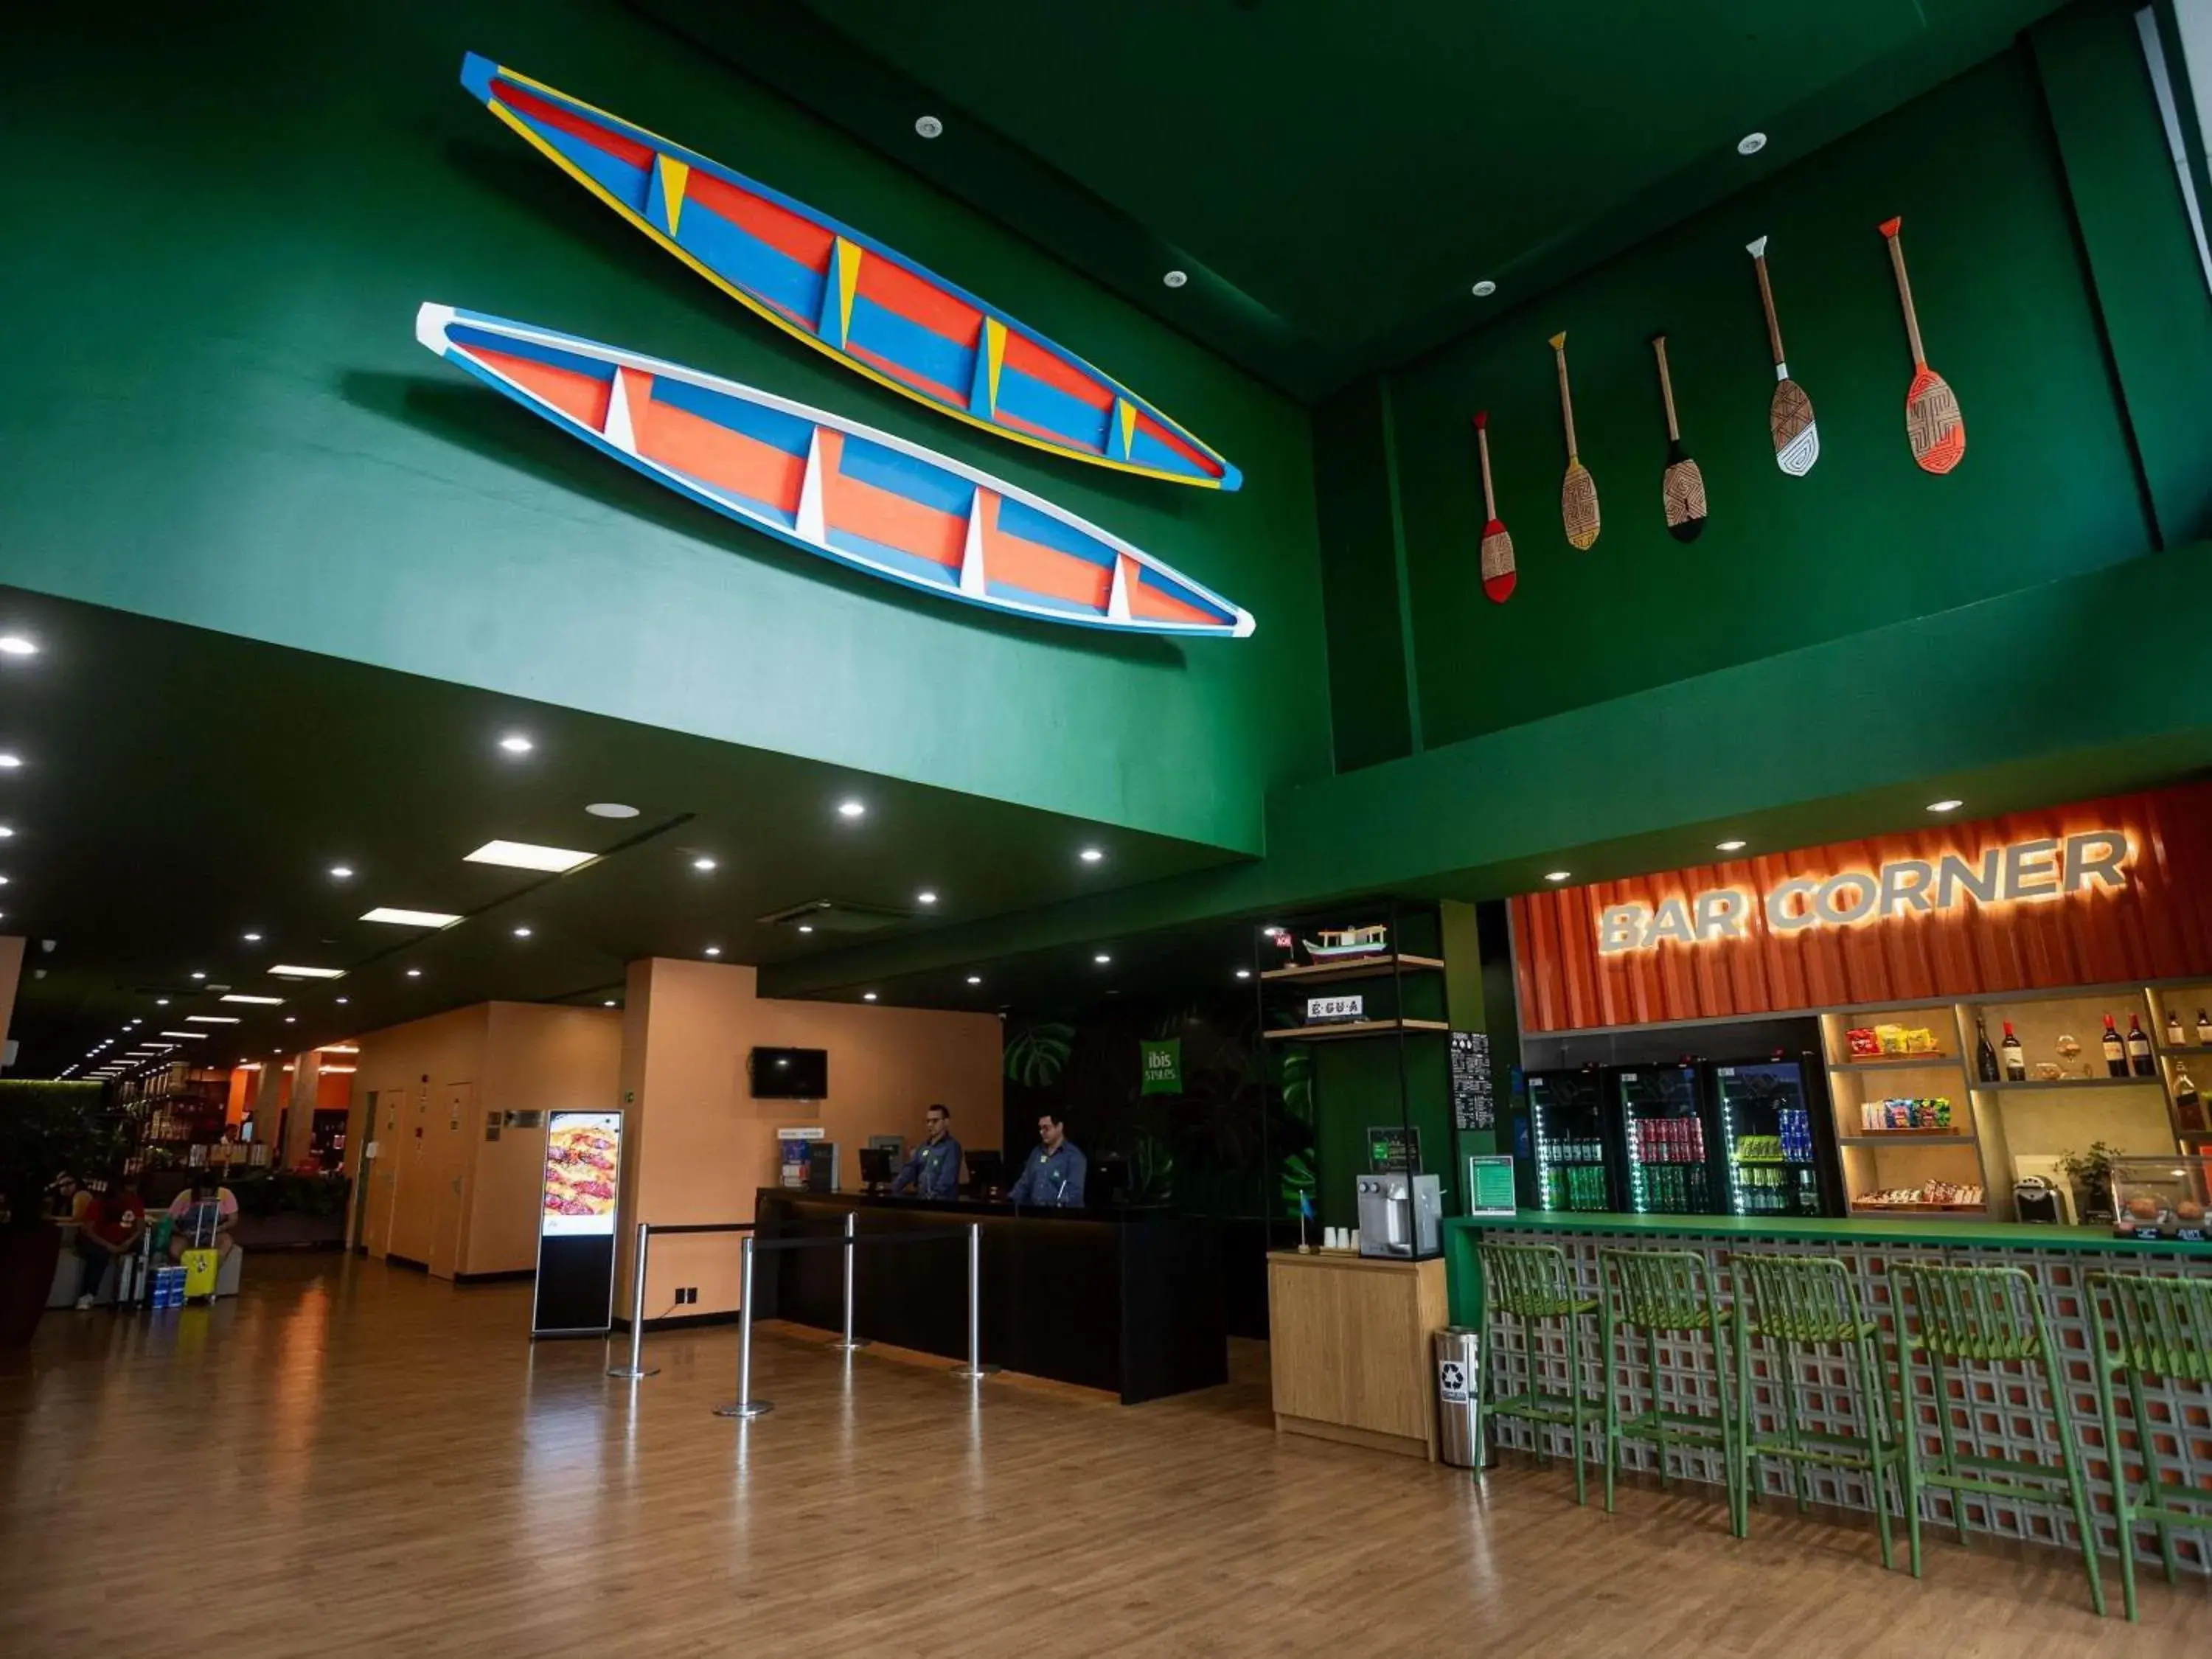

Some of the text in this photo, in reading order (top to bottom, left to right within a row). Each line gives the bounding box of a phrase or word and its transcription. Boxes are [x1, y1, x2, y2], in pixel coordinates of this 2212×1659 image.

[1599, 830, 2128, 952] BAR CORNER
[1149, 1050, 1172, 1068] ibis
